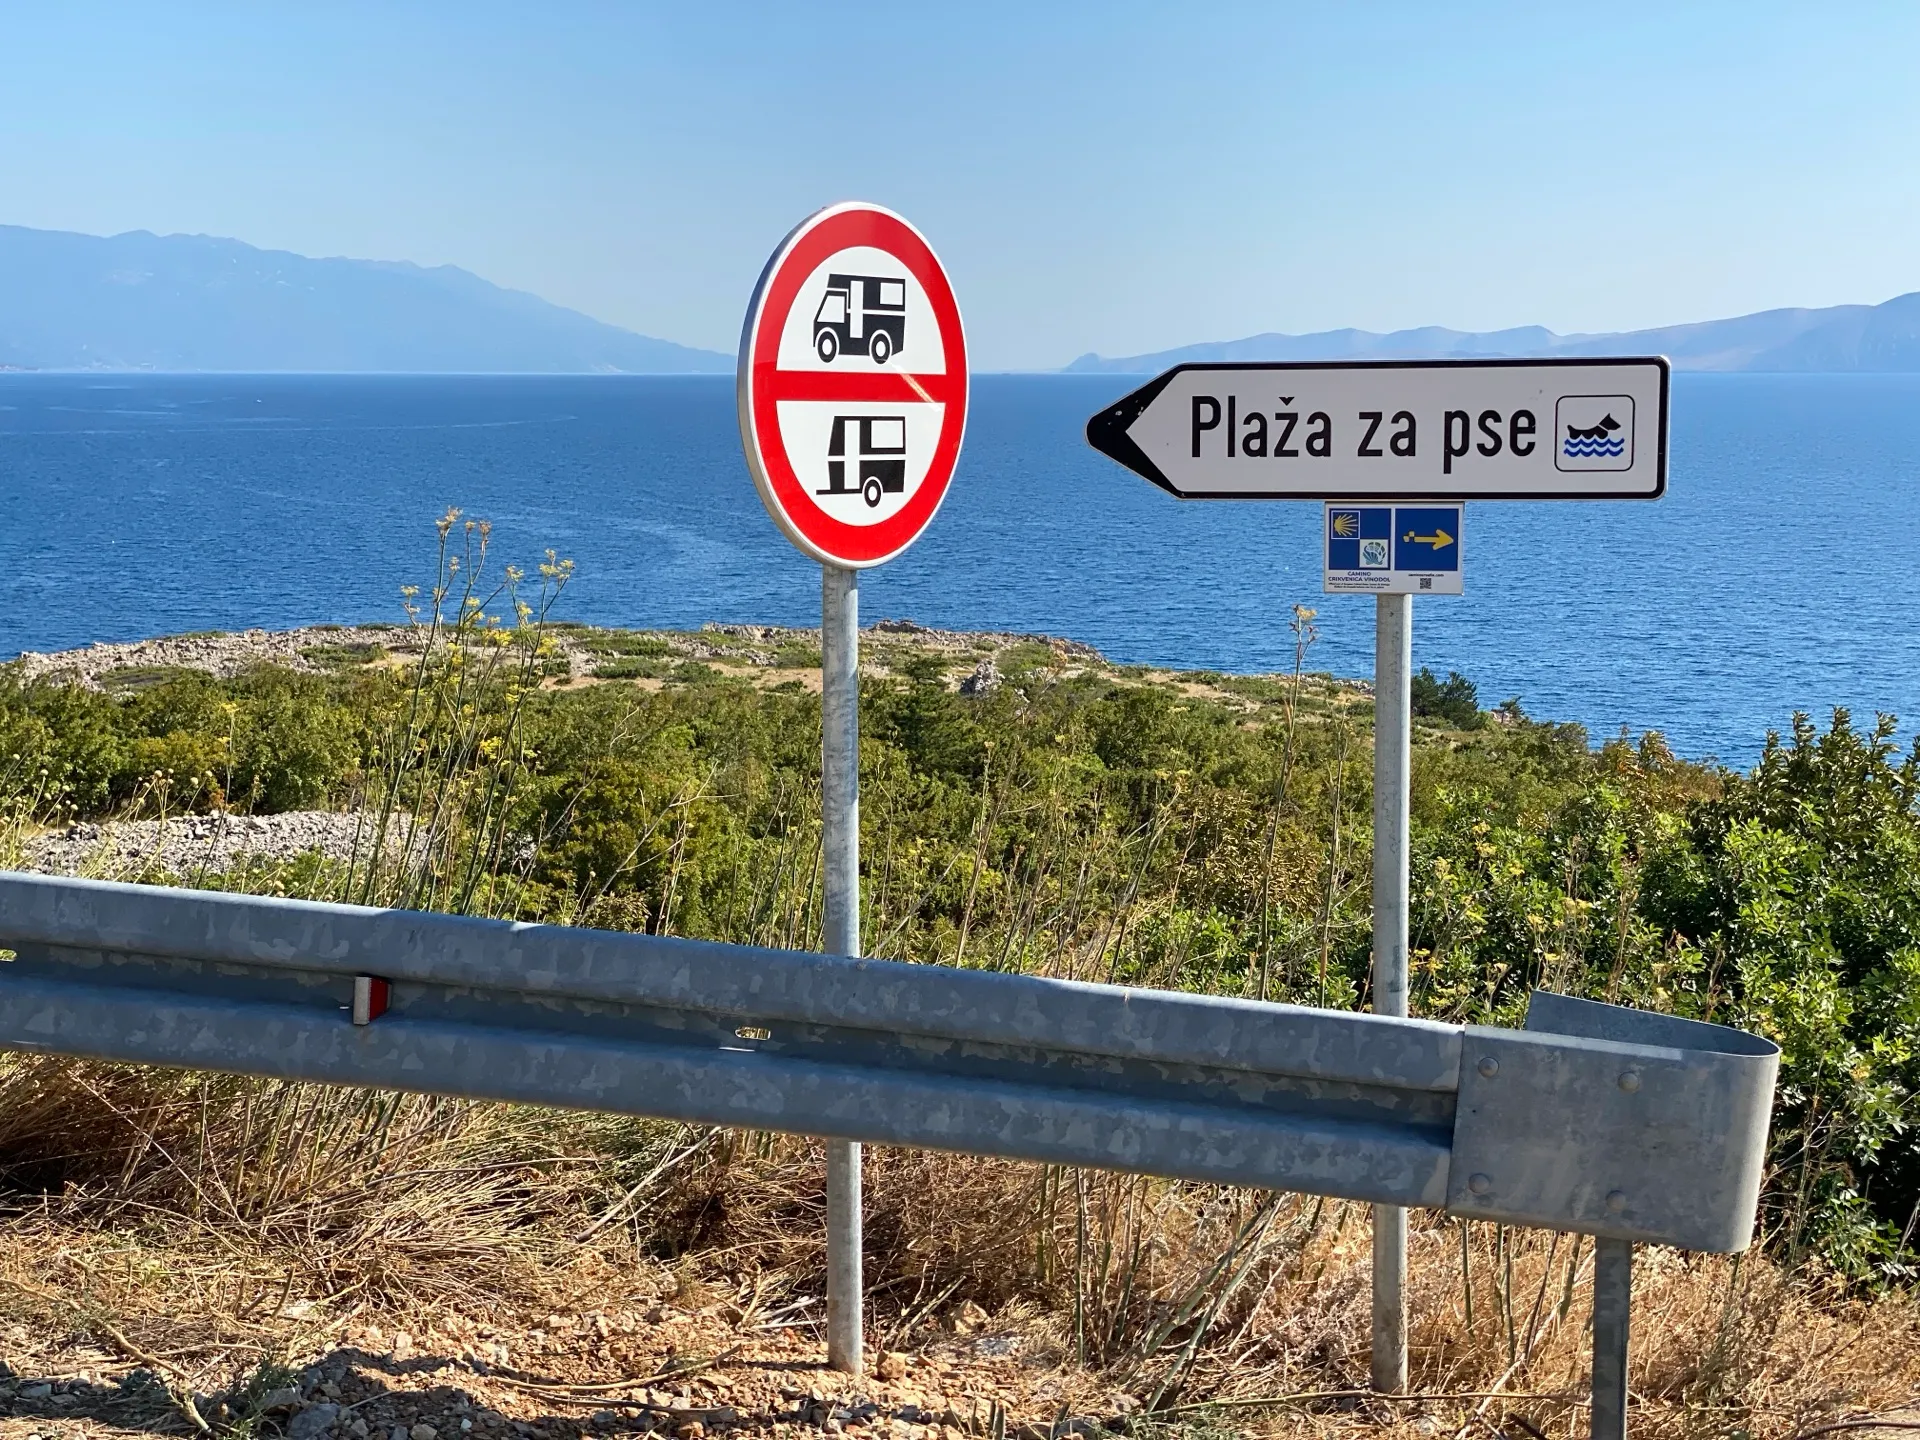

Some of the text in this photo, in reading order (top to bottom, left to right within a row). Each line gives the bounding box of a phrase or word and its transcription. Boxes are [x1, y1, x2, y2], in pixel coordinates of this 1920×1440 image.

[1192, 395, 1536, 475] Plaža za pse
